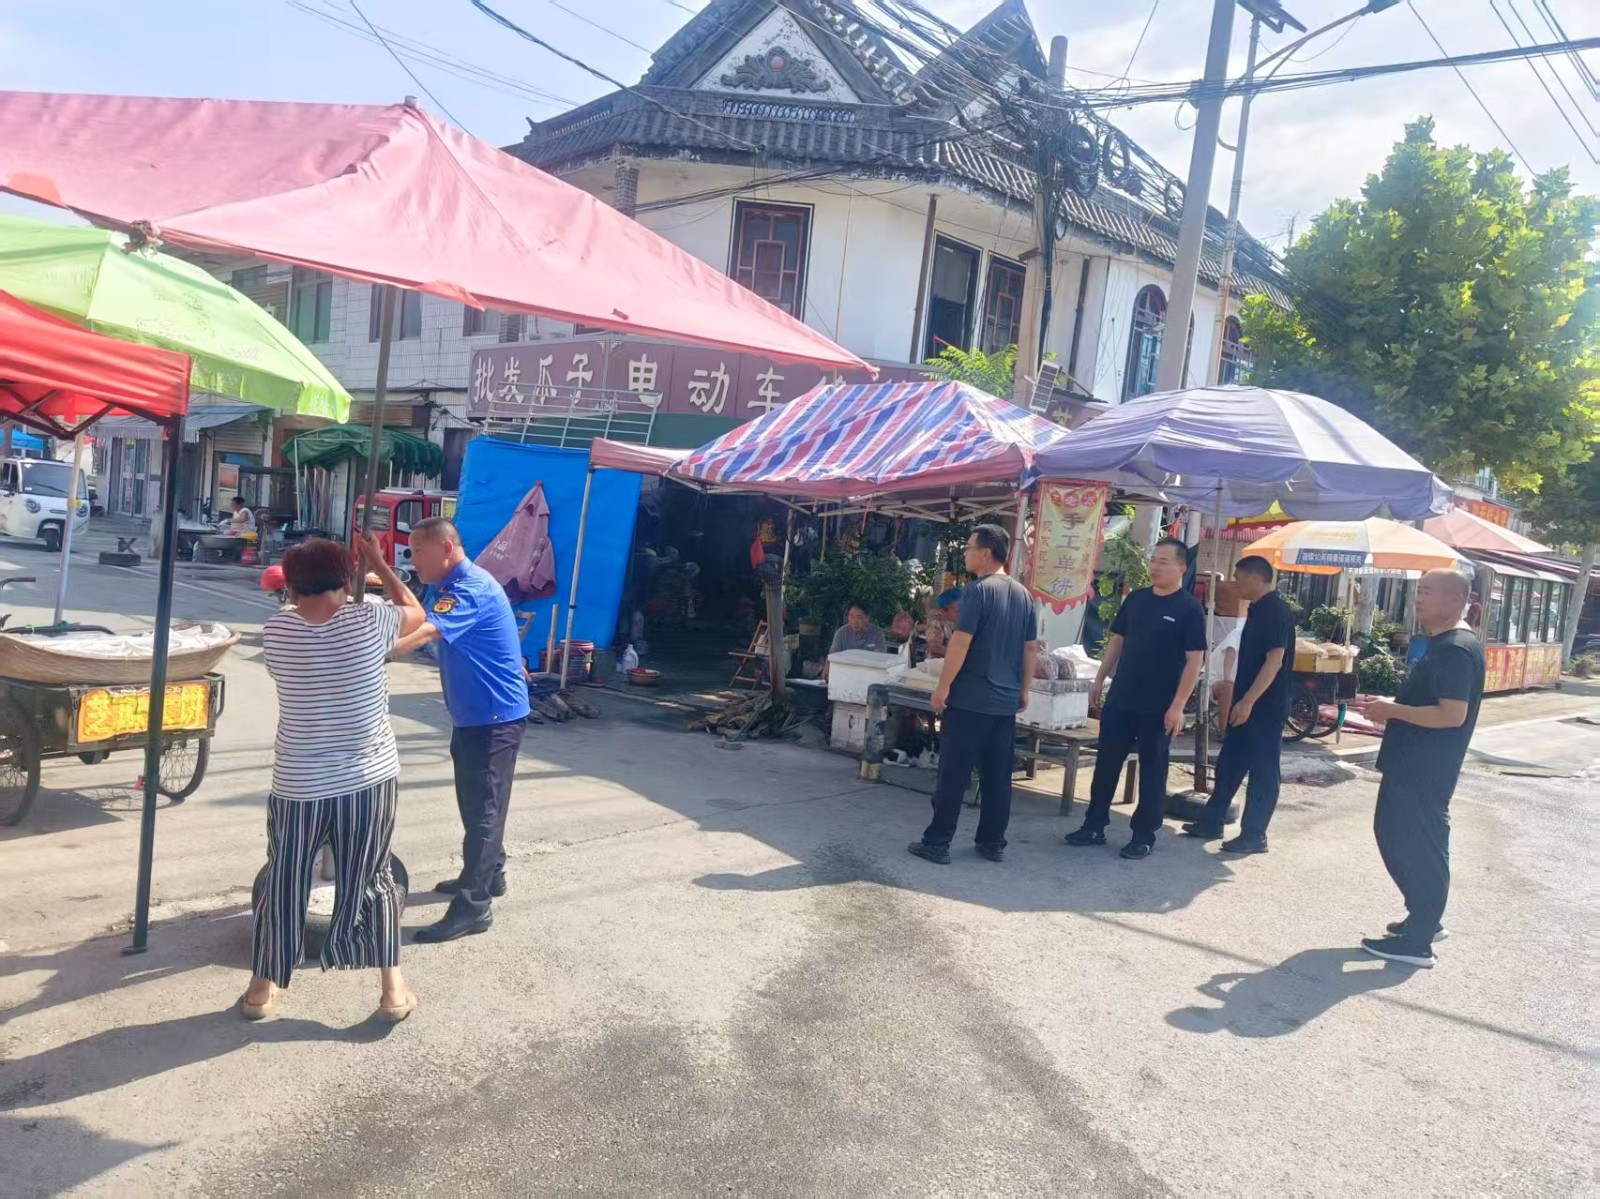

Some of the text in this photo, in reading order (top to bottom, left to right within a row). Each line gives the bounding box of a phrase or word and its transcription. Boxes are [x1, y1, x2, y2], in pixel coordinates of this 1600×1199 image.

[628, 353, 846, 414] 电动车
[1051, 512, 1085, 596] 手工单饼
